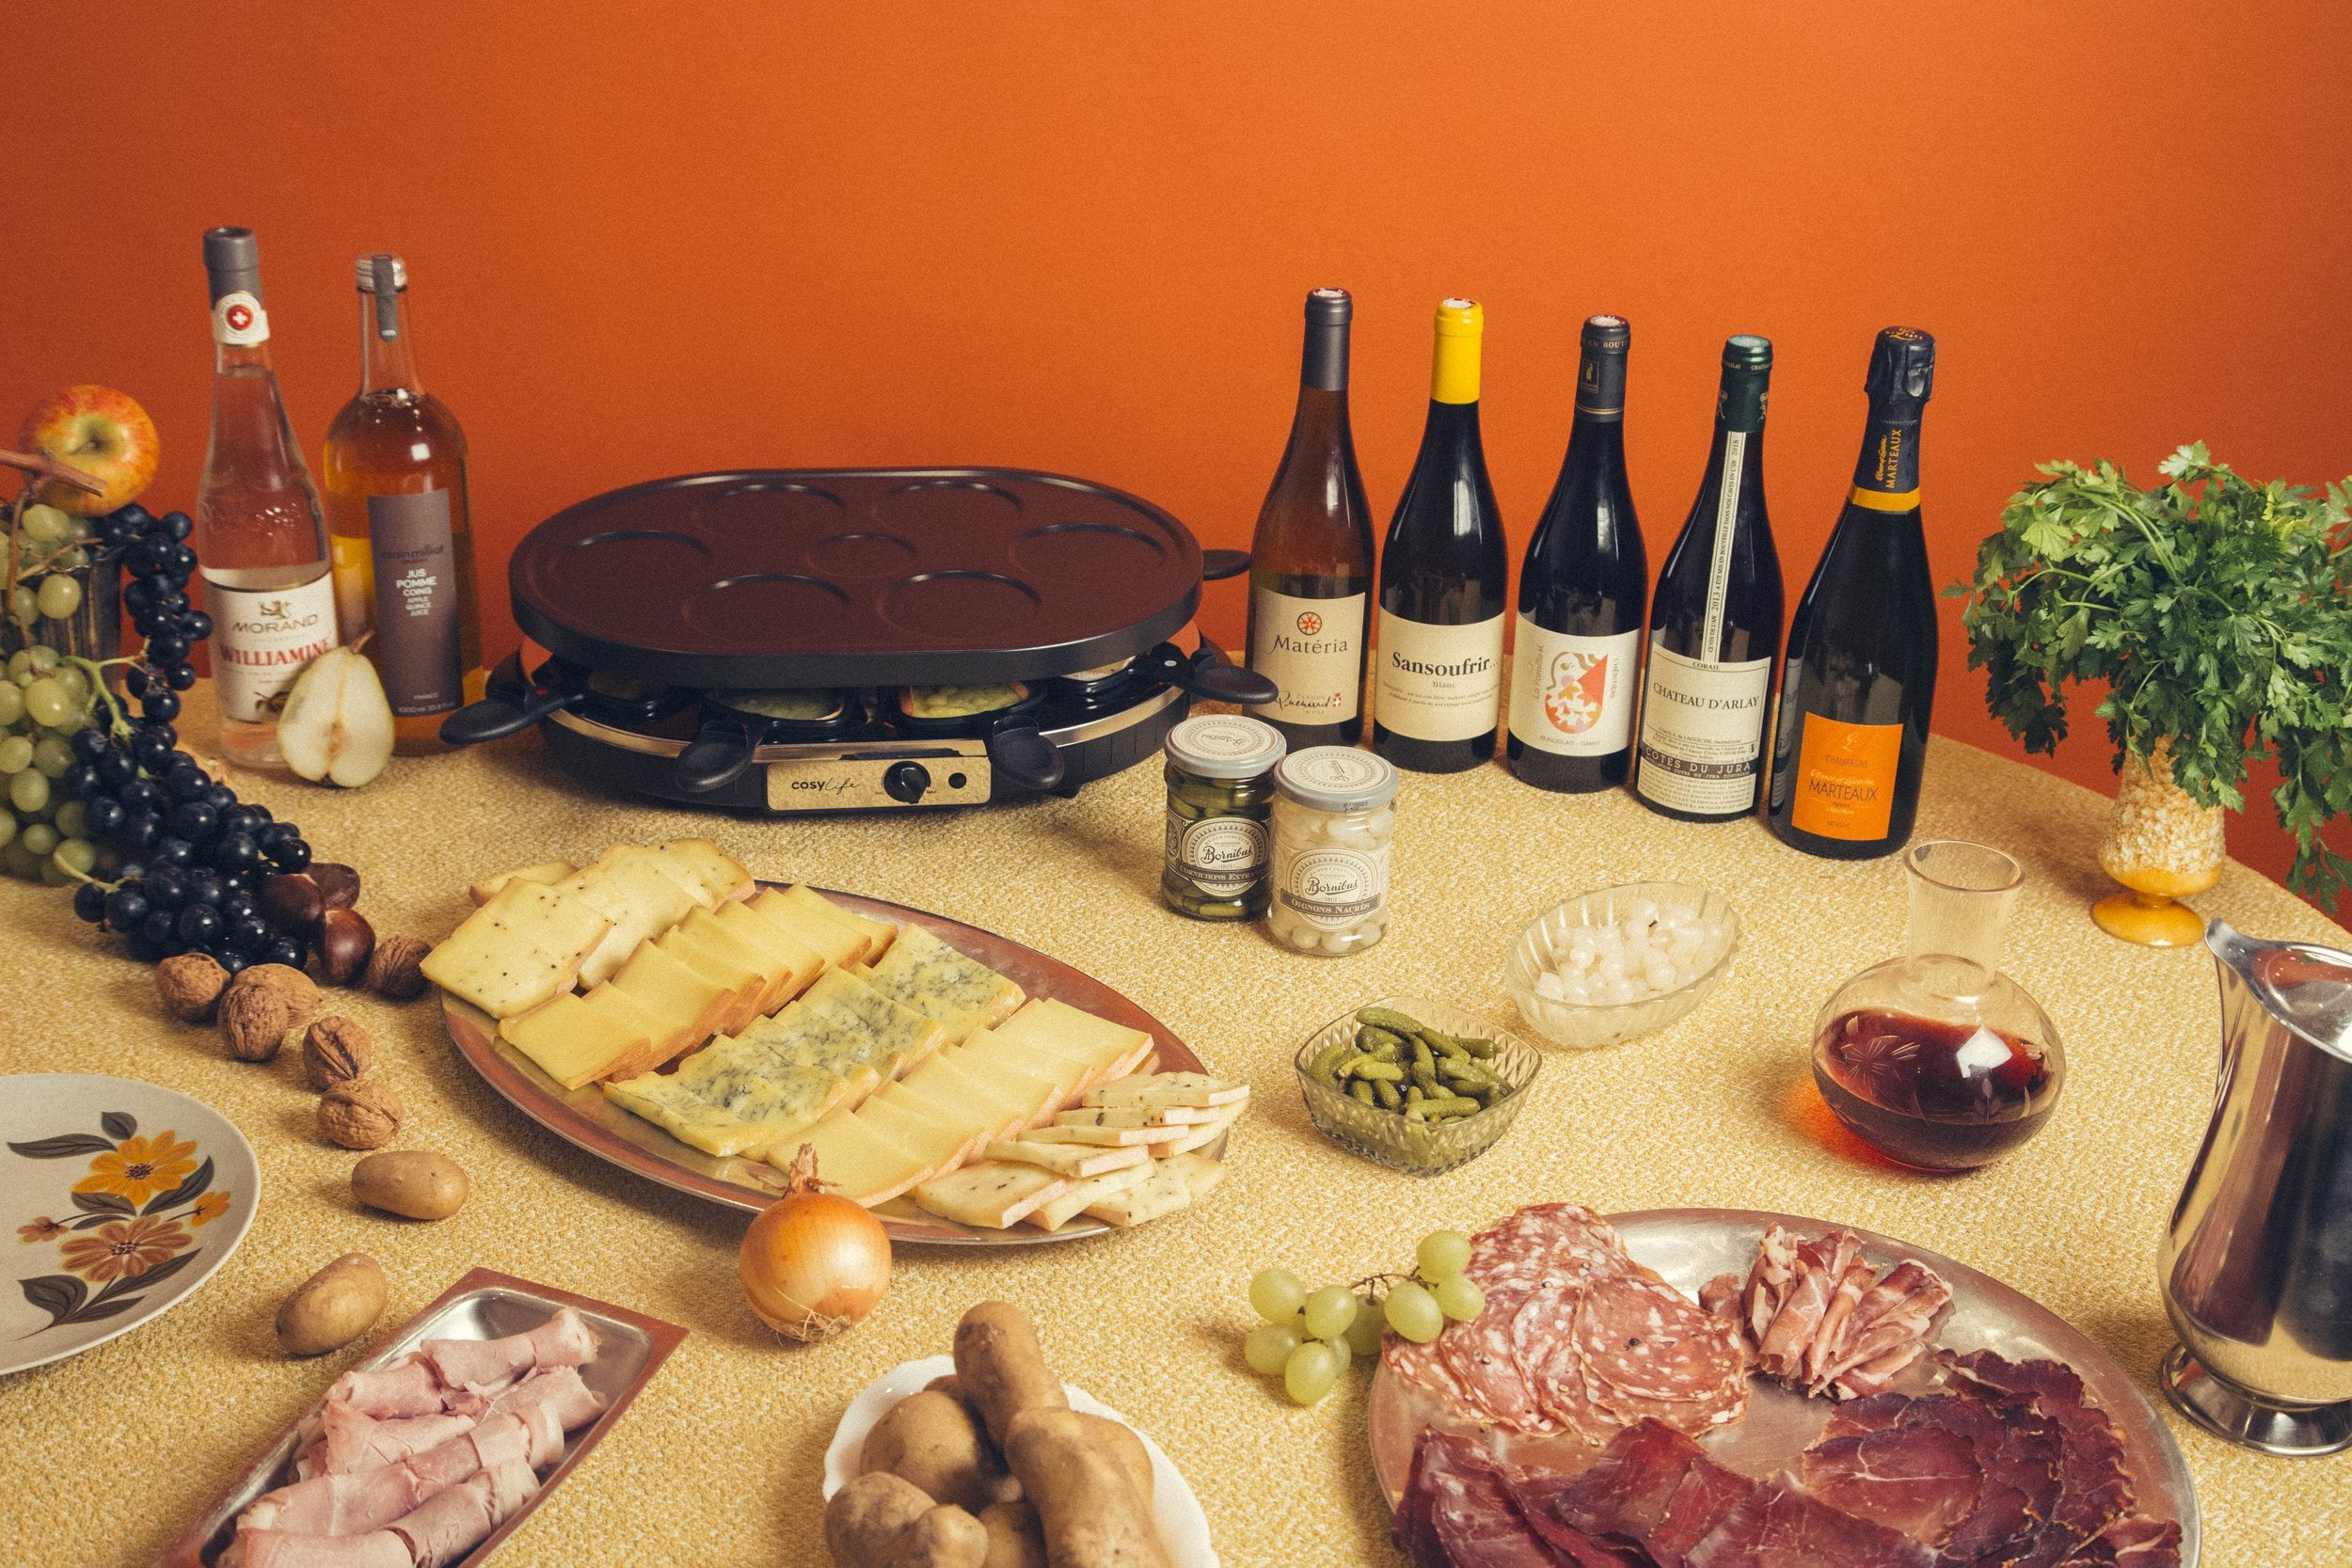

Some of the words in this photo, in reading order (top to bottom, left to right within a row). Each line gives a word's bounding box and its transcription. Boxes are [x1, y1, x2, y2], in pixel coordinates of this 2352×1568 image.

[1731, 438, 1740, 455] 2018
[1885, 429, 1902, 488] MARTEAUX
[1729, 472, 1735, 481] EN
[1718, 526, 1728, 555] BOUTEILLE
[1718, 555, 1724, 563] EN
[406, 568, 426, 578] JUS
[396, 576, 437, 589] POMME
[403, 587, 433, 596] COING
[1711, 592, 1721, 611] 2013
[232, 614, 318, 633] MORAND
[1263, 635, 1348, 654] Matéria
[1692, 661, 1721, 671] CORAIL
[1653, 682, 1705, 707] CHATEAU
[1708, 696, 1759, 709] D'ARLAY
[1645, 747, 1681, 769] COTES
[1690, 763, 1708, 773] DU
[1717, 762, 1751, 774] JURA
[1826, 754, 1867, 768] CHAMPAGNE
[1808, 779, 1880, 801] MARTEAUX
[1200, 846, 1254, 863] Bornibus
[1305, 877, 1359, 895] Bornibus
[1292, 898, 1332, 913] OIGNONS
[1335, 902, 1370, 914] NACRÉS
